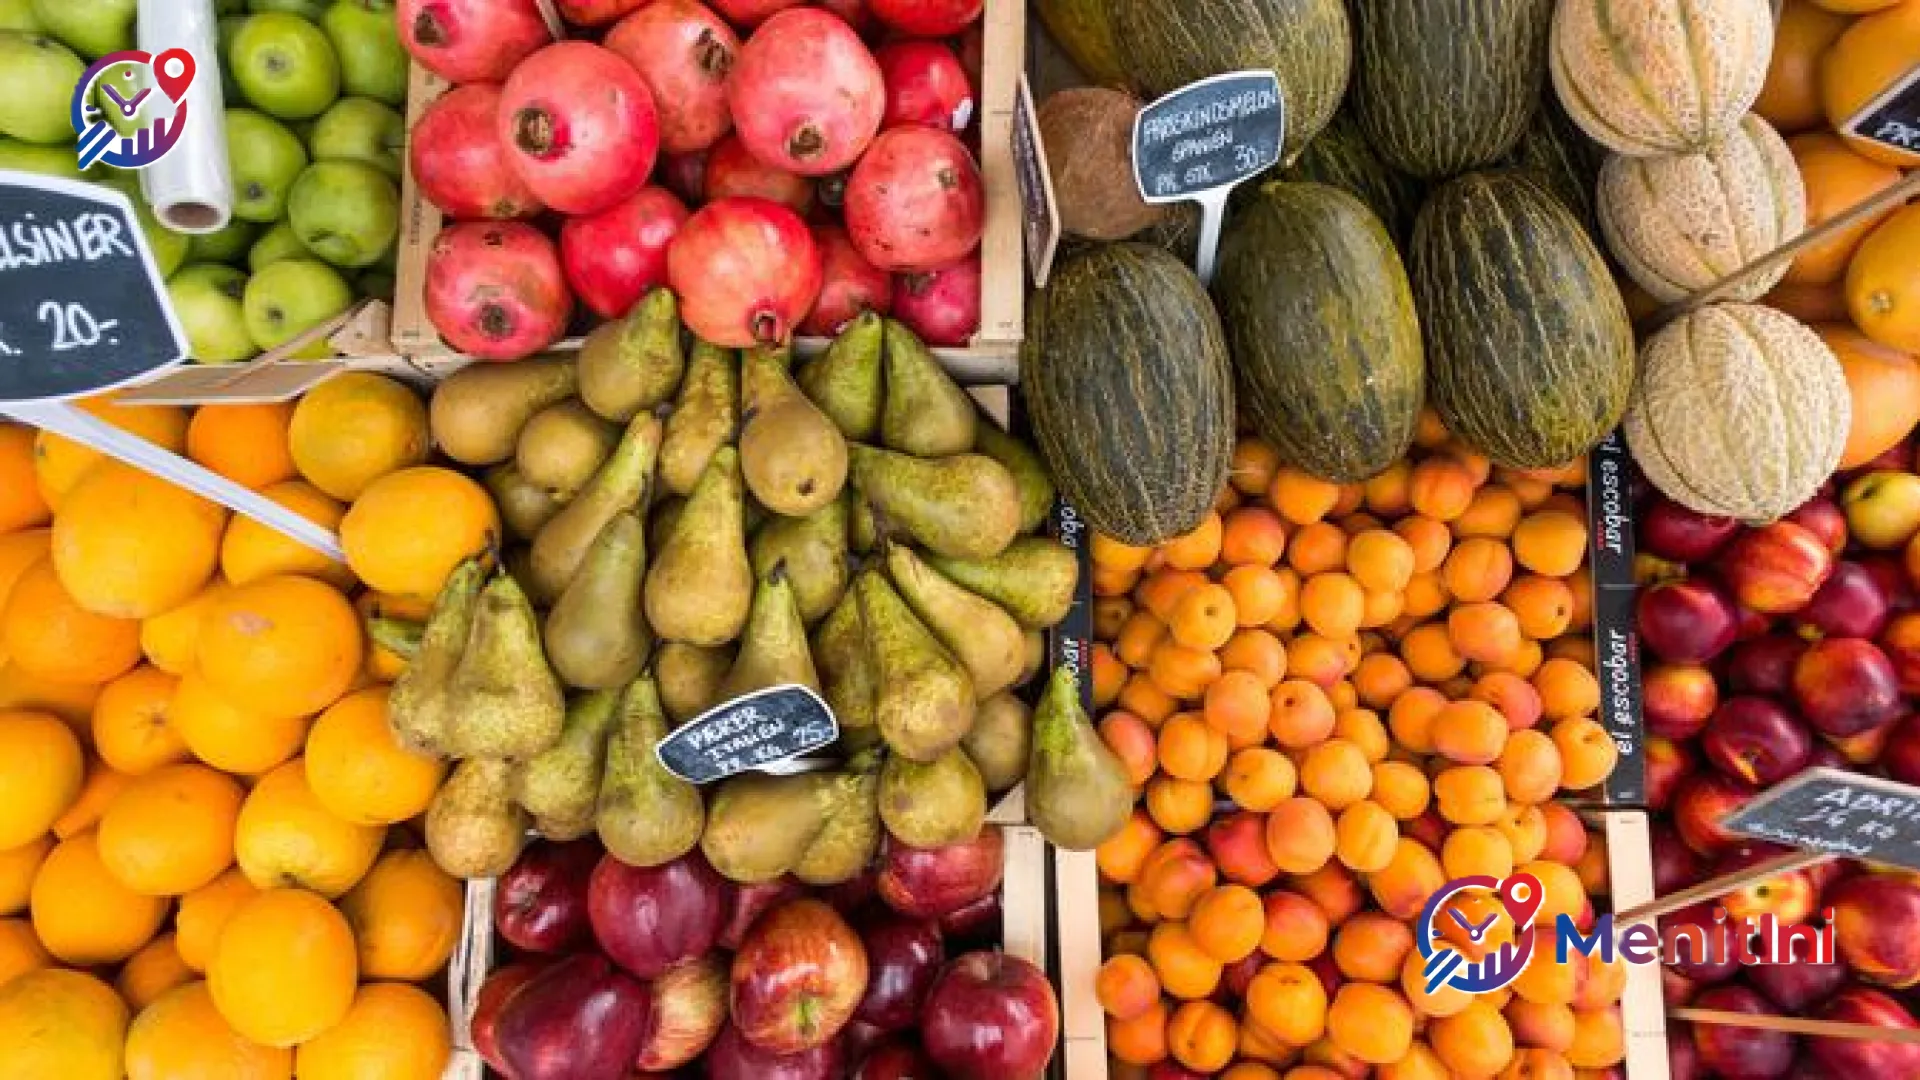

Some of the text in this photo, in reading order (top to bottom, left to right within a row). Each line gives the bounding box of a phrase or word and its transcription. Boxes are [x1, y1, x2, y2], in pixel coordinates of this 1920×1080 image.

[1601, 459, 1629, 553] escobar
[1603, 630, 1635, 756] el escobar
